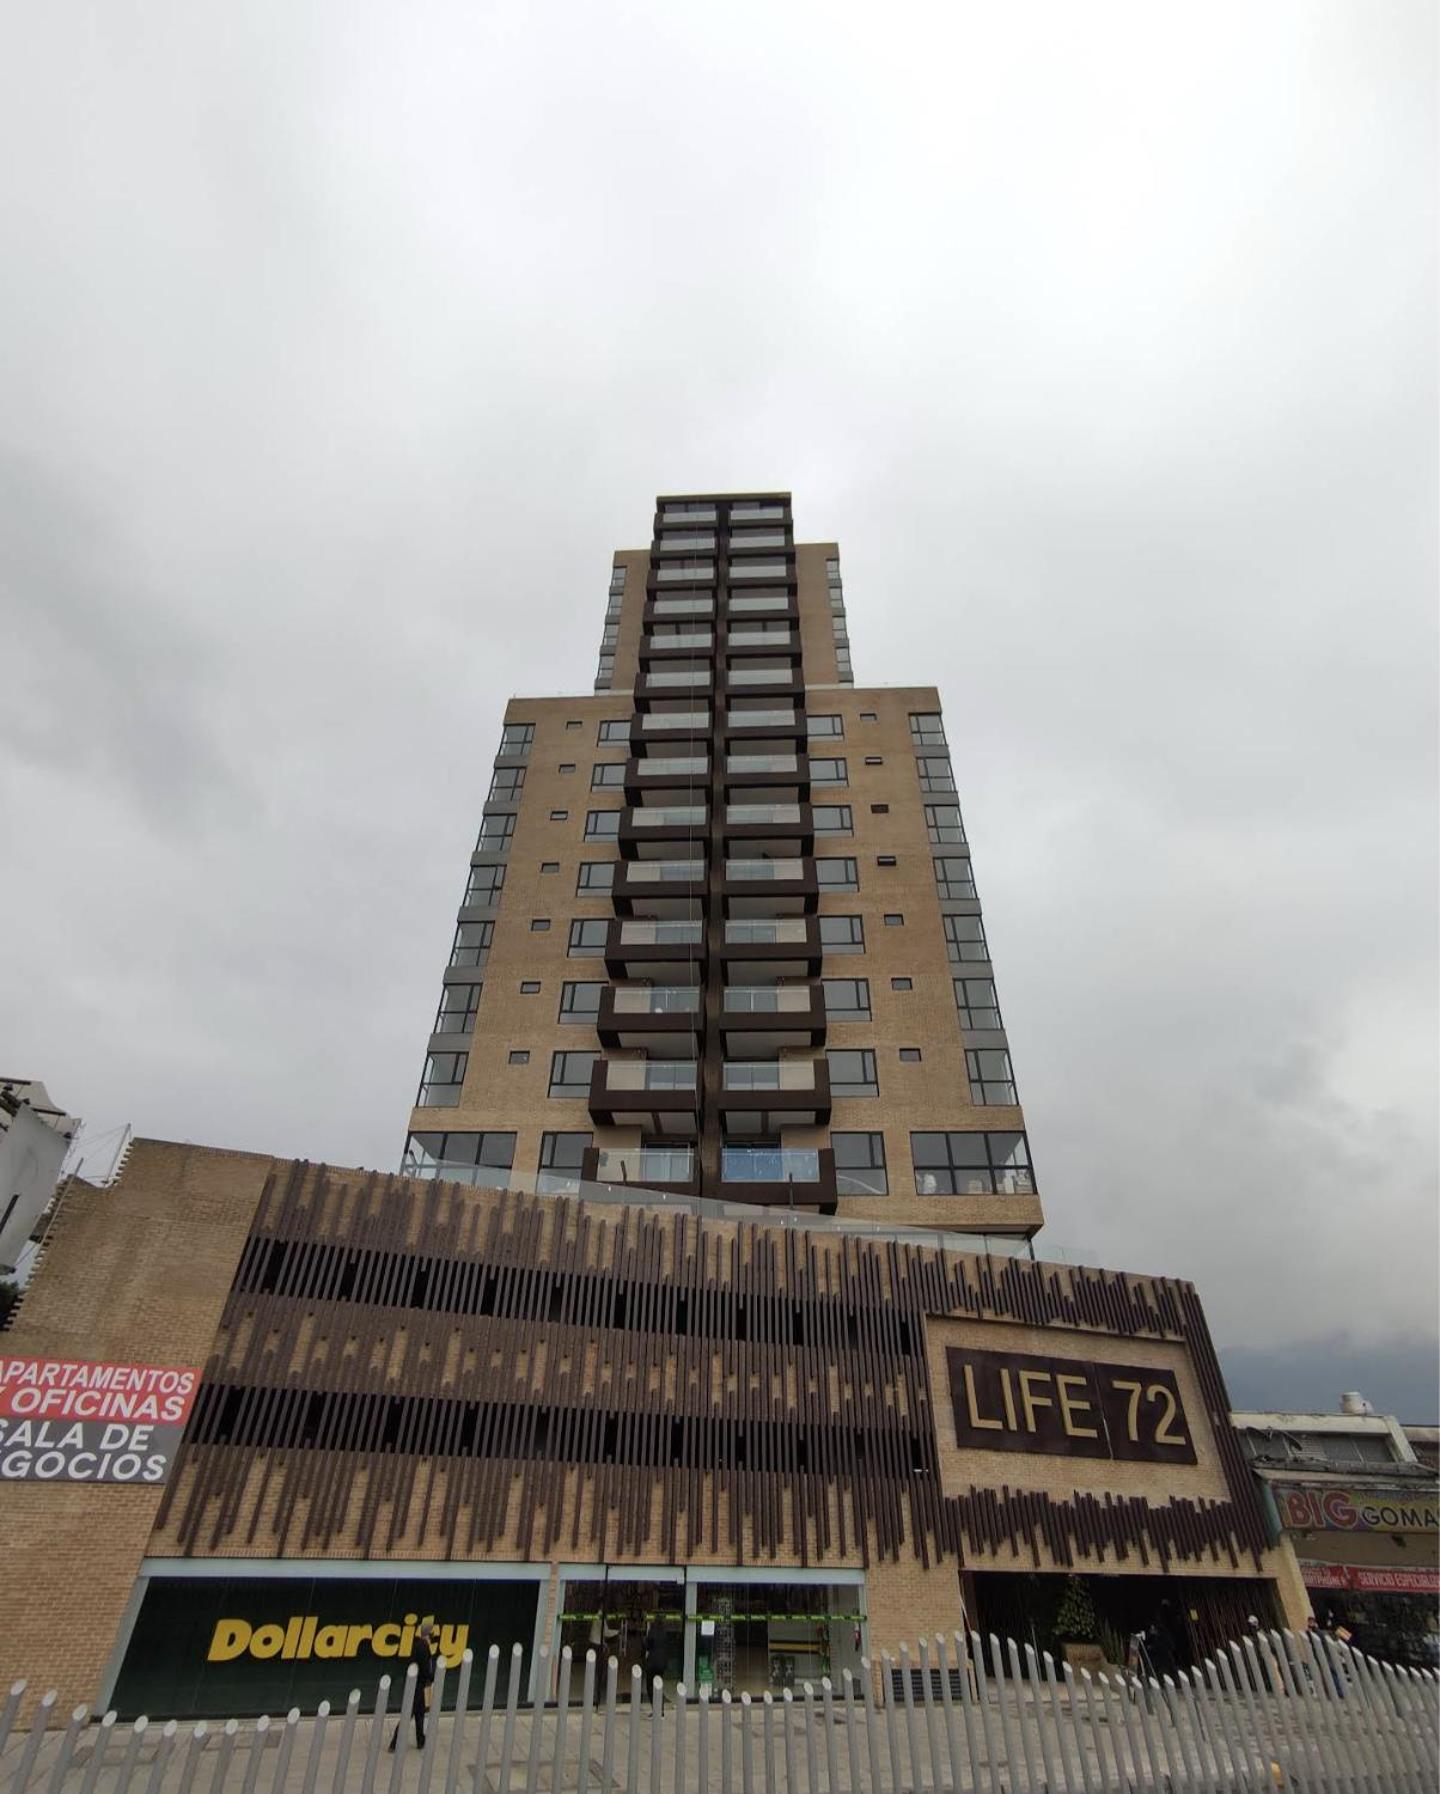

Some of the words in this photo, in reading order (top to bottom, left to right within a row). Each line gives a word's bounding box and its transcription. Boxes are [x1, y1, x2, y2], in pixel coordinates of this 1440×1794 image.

[0, 1360, 195, 1395] PARTAMENTOS
[11, 1387, 185, 1421] OFICINAS
[963, 1364, 1098, 1438] LIFE
[1112, 1380, 1186, 1445] 72
[100, 1423, 154, 1451] DE
[0, 1450, 167, 1481] GOCIOS
[1287, 1489, 1358, 1529] BIG
[1361, 1505, 1438, 1528] GOMA
